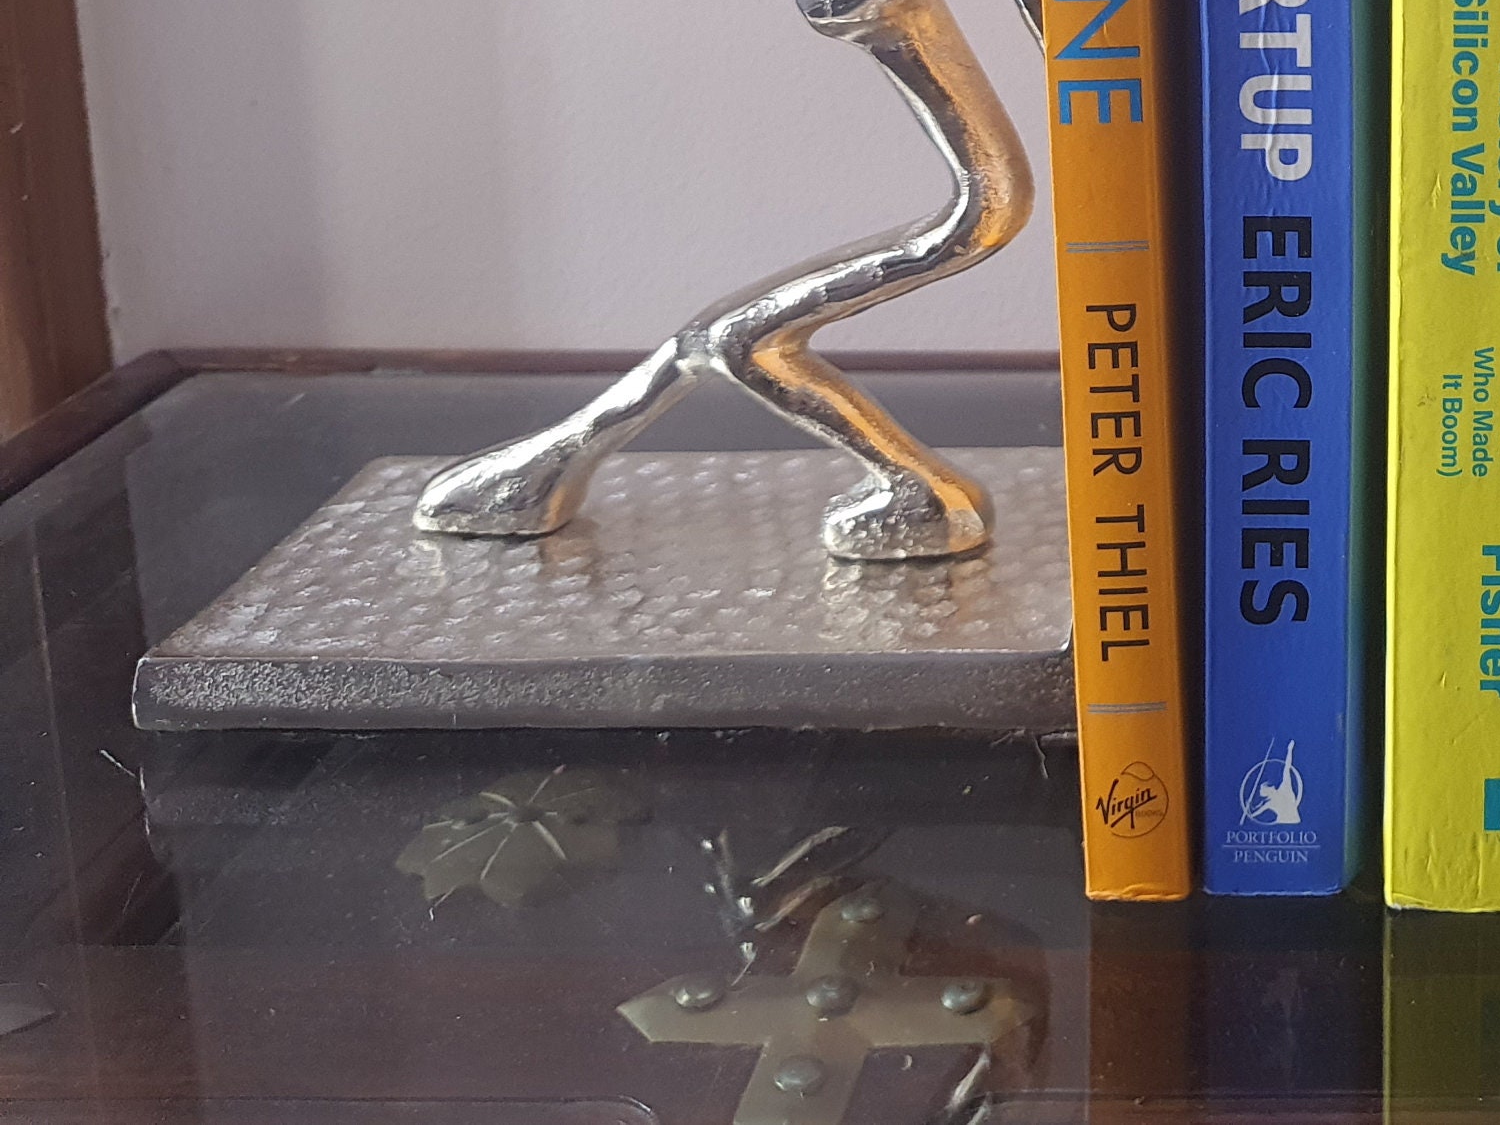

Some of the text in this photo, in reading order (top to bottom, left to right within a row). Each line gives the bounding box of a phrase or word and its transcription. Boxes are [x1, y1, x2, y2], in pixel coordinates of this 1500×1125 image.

[1442, 144, 1486, 274] Valley
[1240, 216, 1312, 625] ERIC RIES
[1437, 374, 1463, 478] It Boom)
[1472, 346, 1495, 477] Who Made
[1086, 304, 1150, 661] PETER THIEL
[1096, 778, 1157, 829] Virgin
[1225, 830, 1318, 844] PORTFOLIO
[1233, 849, 1309, 864] PENGUIN
